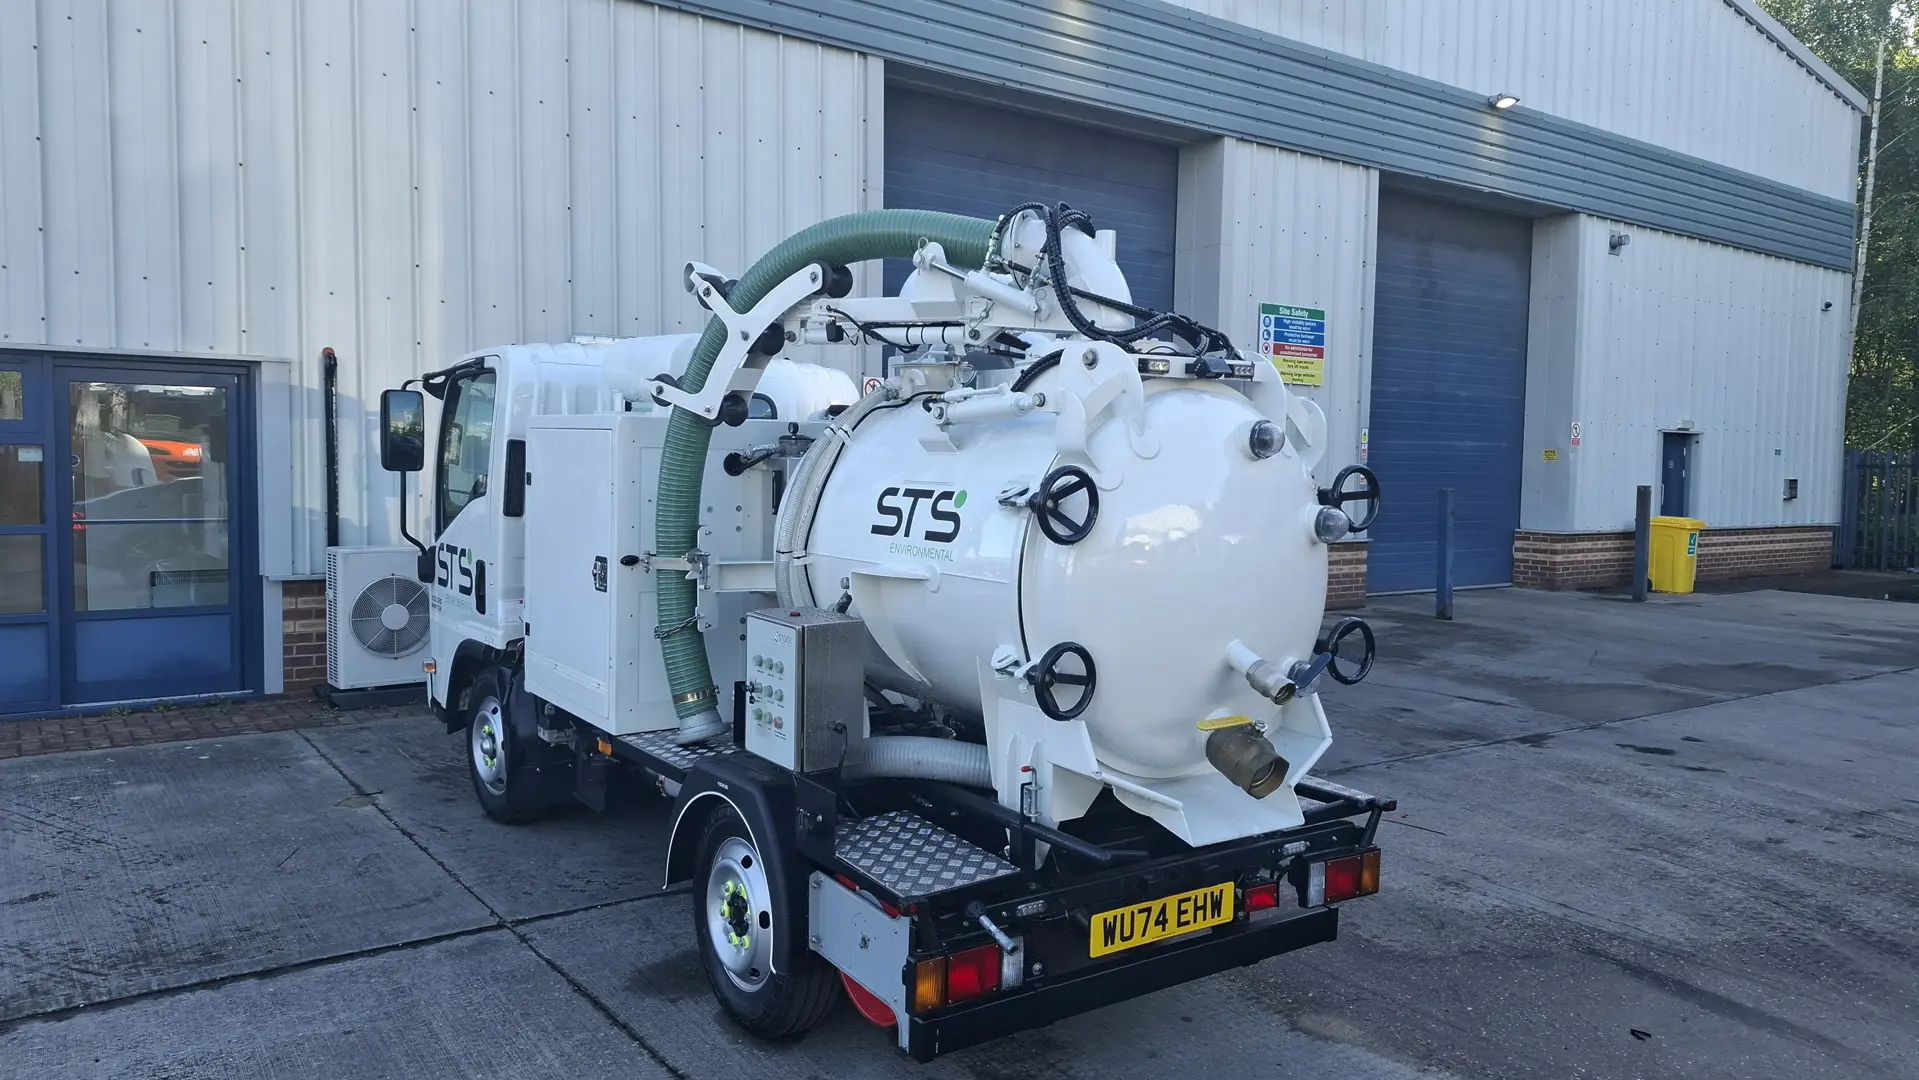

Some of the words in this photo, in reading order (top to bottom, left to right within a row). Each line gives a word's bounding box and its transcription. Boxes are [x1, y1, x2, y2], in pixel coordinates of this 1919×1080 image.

[1279, 307, 1290, 316] Site
[1291, 308, 1308, 318] Safety
[871, 486, 961, 543] STS
[437, 542, 473, 596] STS
[889, 542, 954, 562] ENVIRONMENTAL
[1103, 902, 1168, 947] WU74
[1176, 889, 1224, 928] EHW
